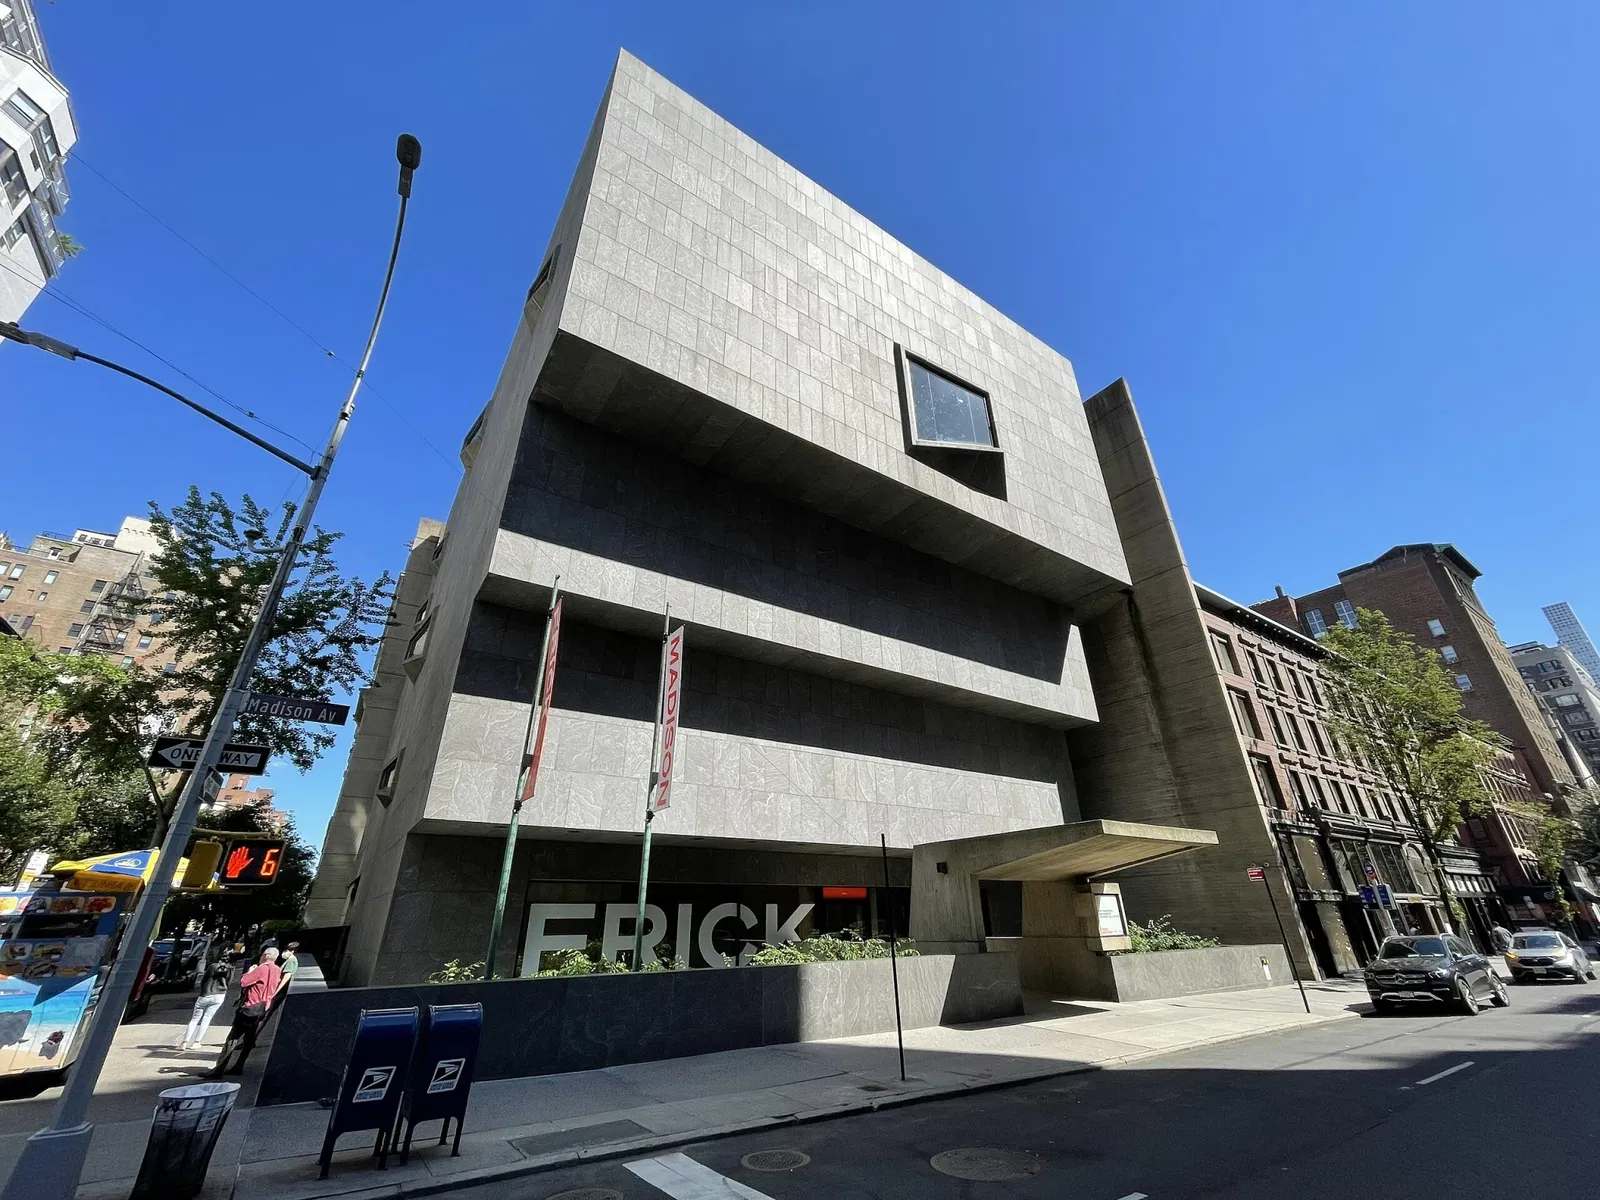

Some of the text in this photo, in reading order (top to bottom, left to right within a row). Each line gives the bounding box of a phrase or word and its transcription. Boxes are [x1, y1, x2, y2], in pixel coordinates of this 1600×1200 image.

[249, 697, 337, 722] Madison Av
[657, 635, 681, 807] MADISON
[219, 751, 255, 766] WAY
[260, 848, 280, 876] 6
[521, 903, 816, 978] FRICK
